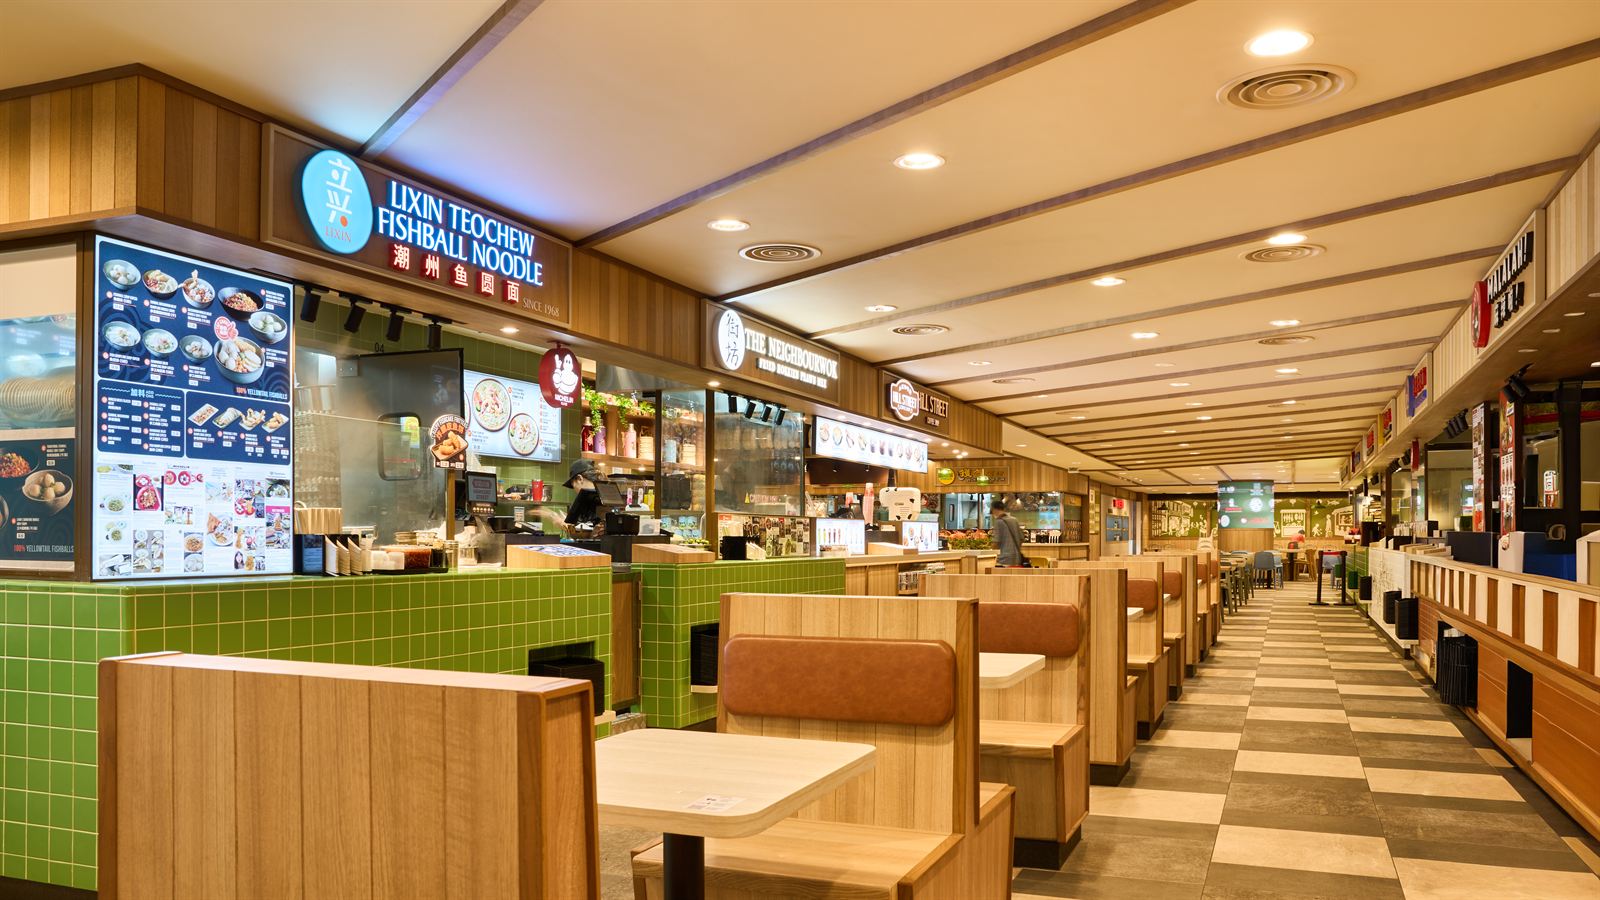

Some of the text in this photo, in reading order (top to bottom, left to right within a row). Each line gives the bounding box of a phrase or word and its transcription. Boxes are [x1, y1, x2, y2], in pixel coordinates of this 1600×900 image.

[325, 226, 352, 244] LIXIN
[391, 180, 535, 256] LIXIN TEOCHEW
[378, 207, 543, 287] FISHBALL NOODLE
[393, 245, 520, 303] 潮州鱼圆面
[1487, 232, 1529, 304] MALALAH!
[522, 297, 560, 317] SINCE 1968
[374, 342, 385, 352] 04
[745, 328, 838, 380] THE NEIGHBOURWOK
[930, 395, 949, 418] STREET
[26, 544, 51, 553] YELLOWTAIL
